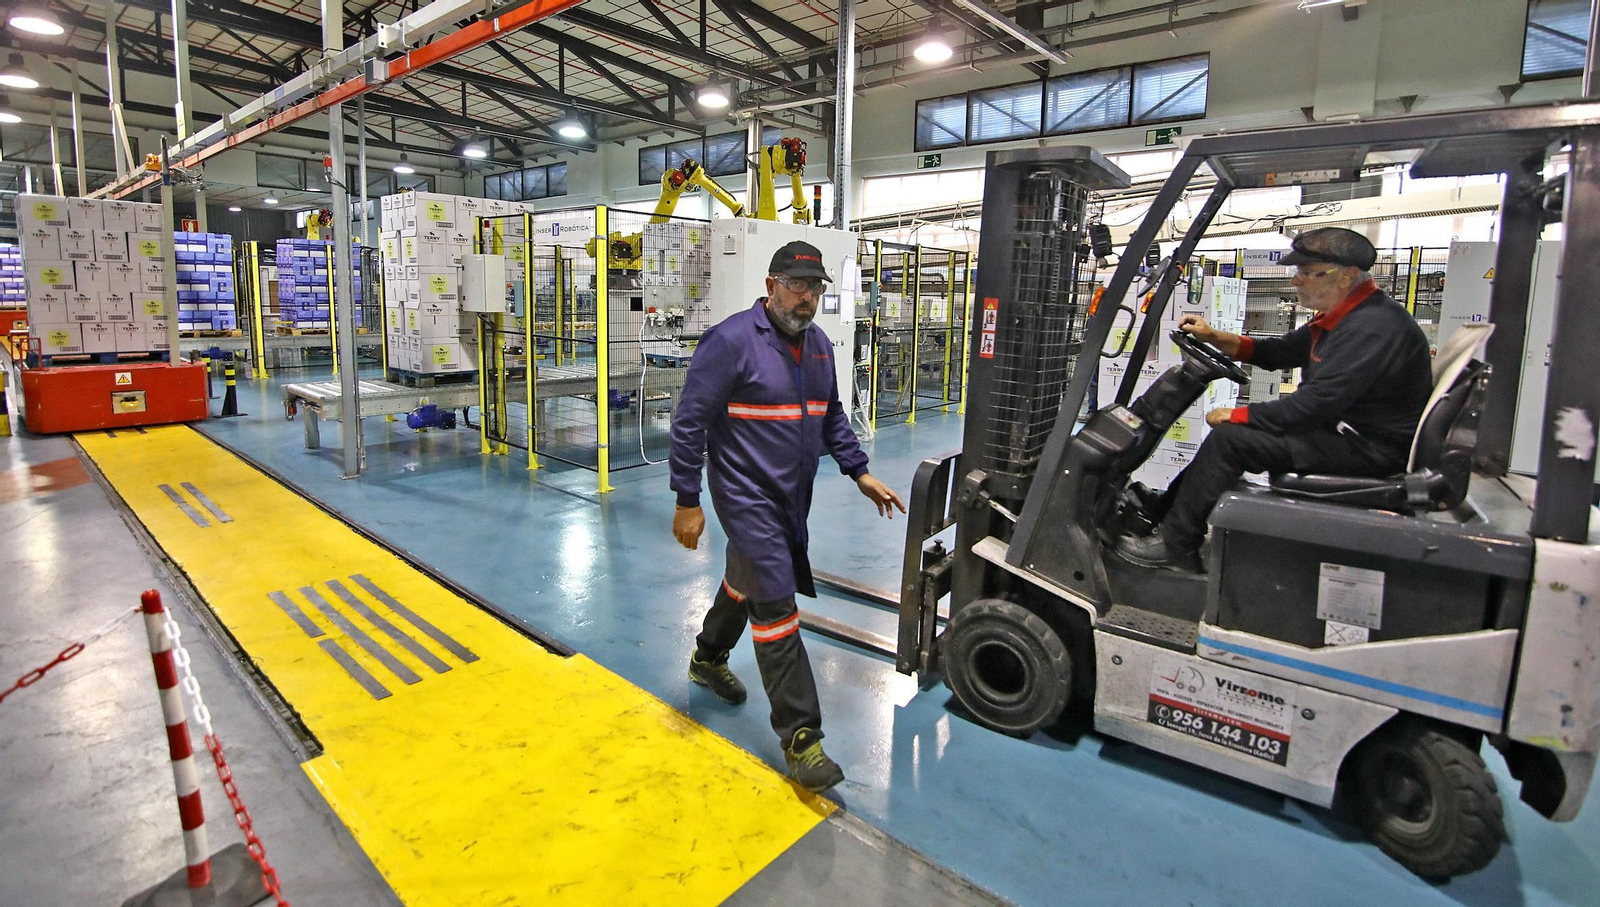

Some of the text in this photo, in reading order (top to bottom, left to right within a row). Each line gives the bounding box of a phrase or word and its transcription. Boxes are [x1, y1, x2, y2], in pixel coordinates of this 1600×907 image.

[1215, 676, 1285, 705] Virrome
[1172, 709, 1281, 755] 956 144 103
